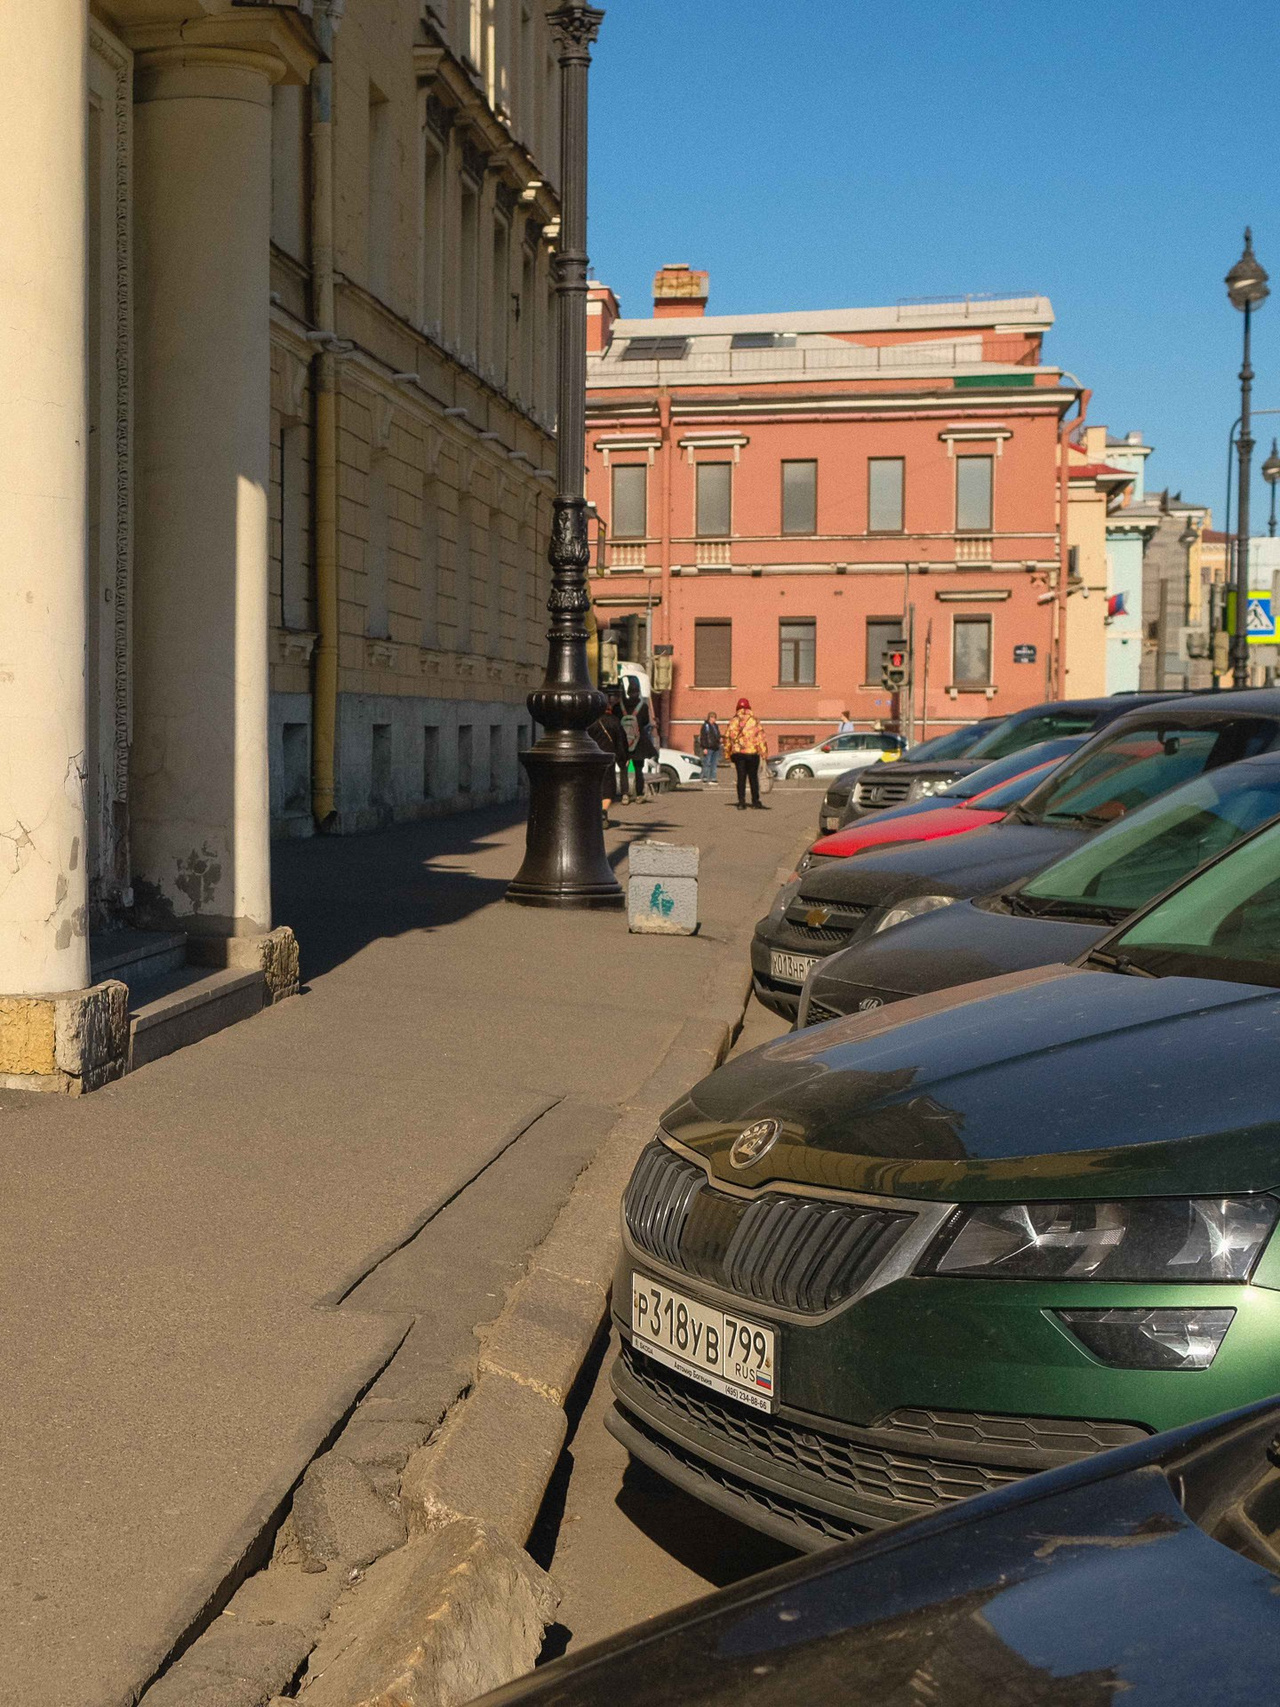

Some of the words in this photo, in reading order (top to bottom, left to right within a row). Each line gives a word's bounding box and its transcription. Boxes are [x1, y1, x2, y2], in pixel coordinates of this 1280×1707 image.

[860, 998, 879, 1010] KIA
[638, 1288, 720, 1366] Р318УВ
[725, 1319, 766, 1370] 799
[735, 1363, 756, 1383] RUS
[725, 1384, 739, 1399] (495)
